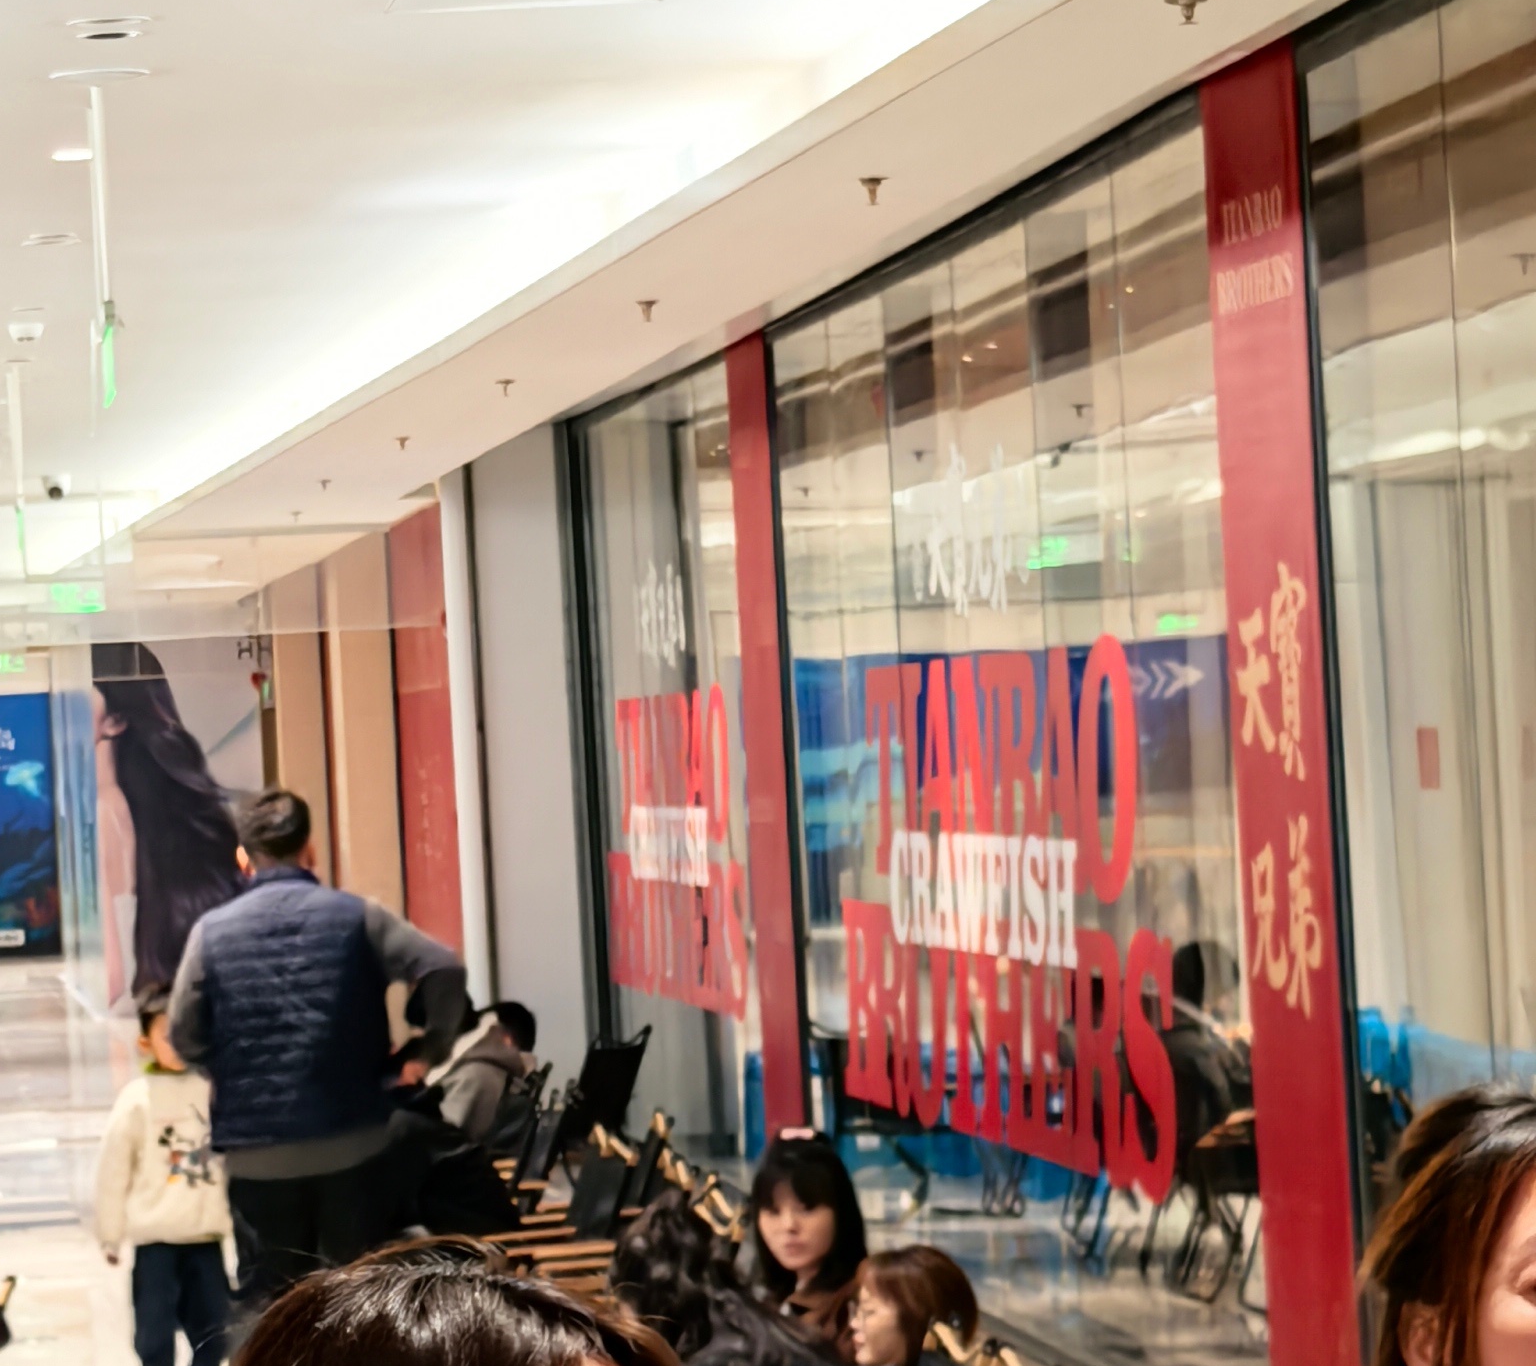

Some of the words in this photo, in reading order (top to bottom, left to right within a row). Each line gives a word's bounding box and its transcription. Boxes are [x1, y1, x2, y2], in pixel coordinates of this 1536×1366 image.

[866, 635, 1137, 904] TIANBAO
[889, 828, 1079, 970] CRAWFISH
[841, 898, 1178, 1204] BROTHERS
